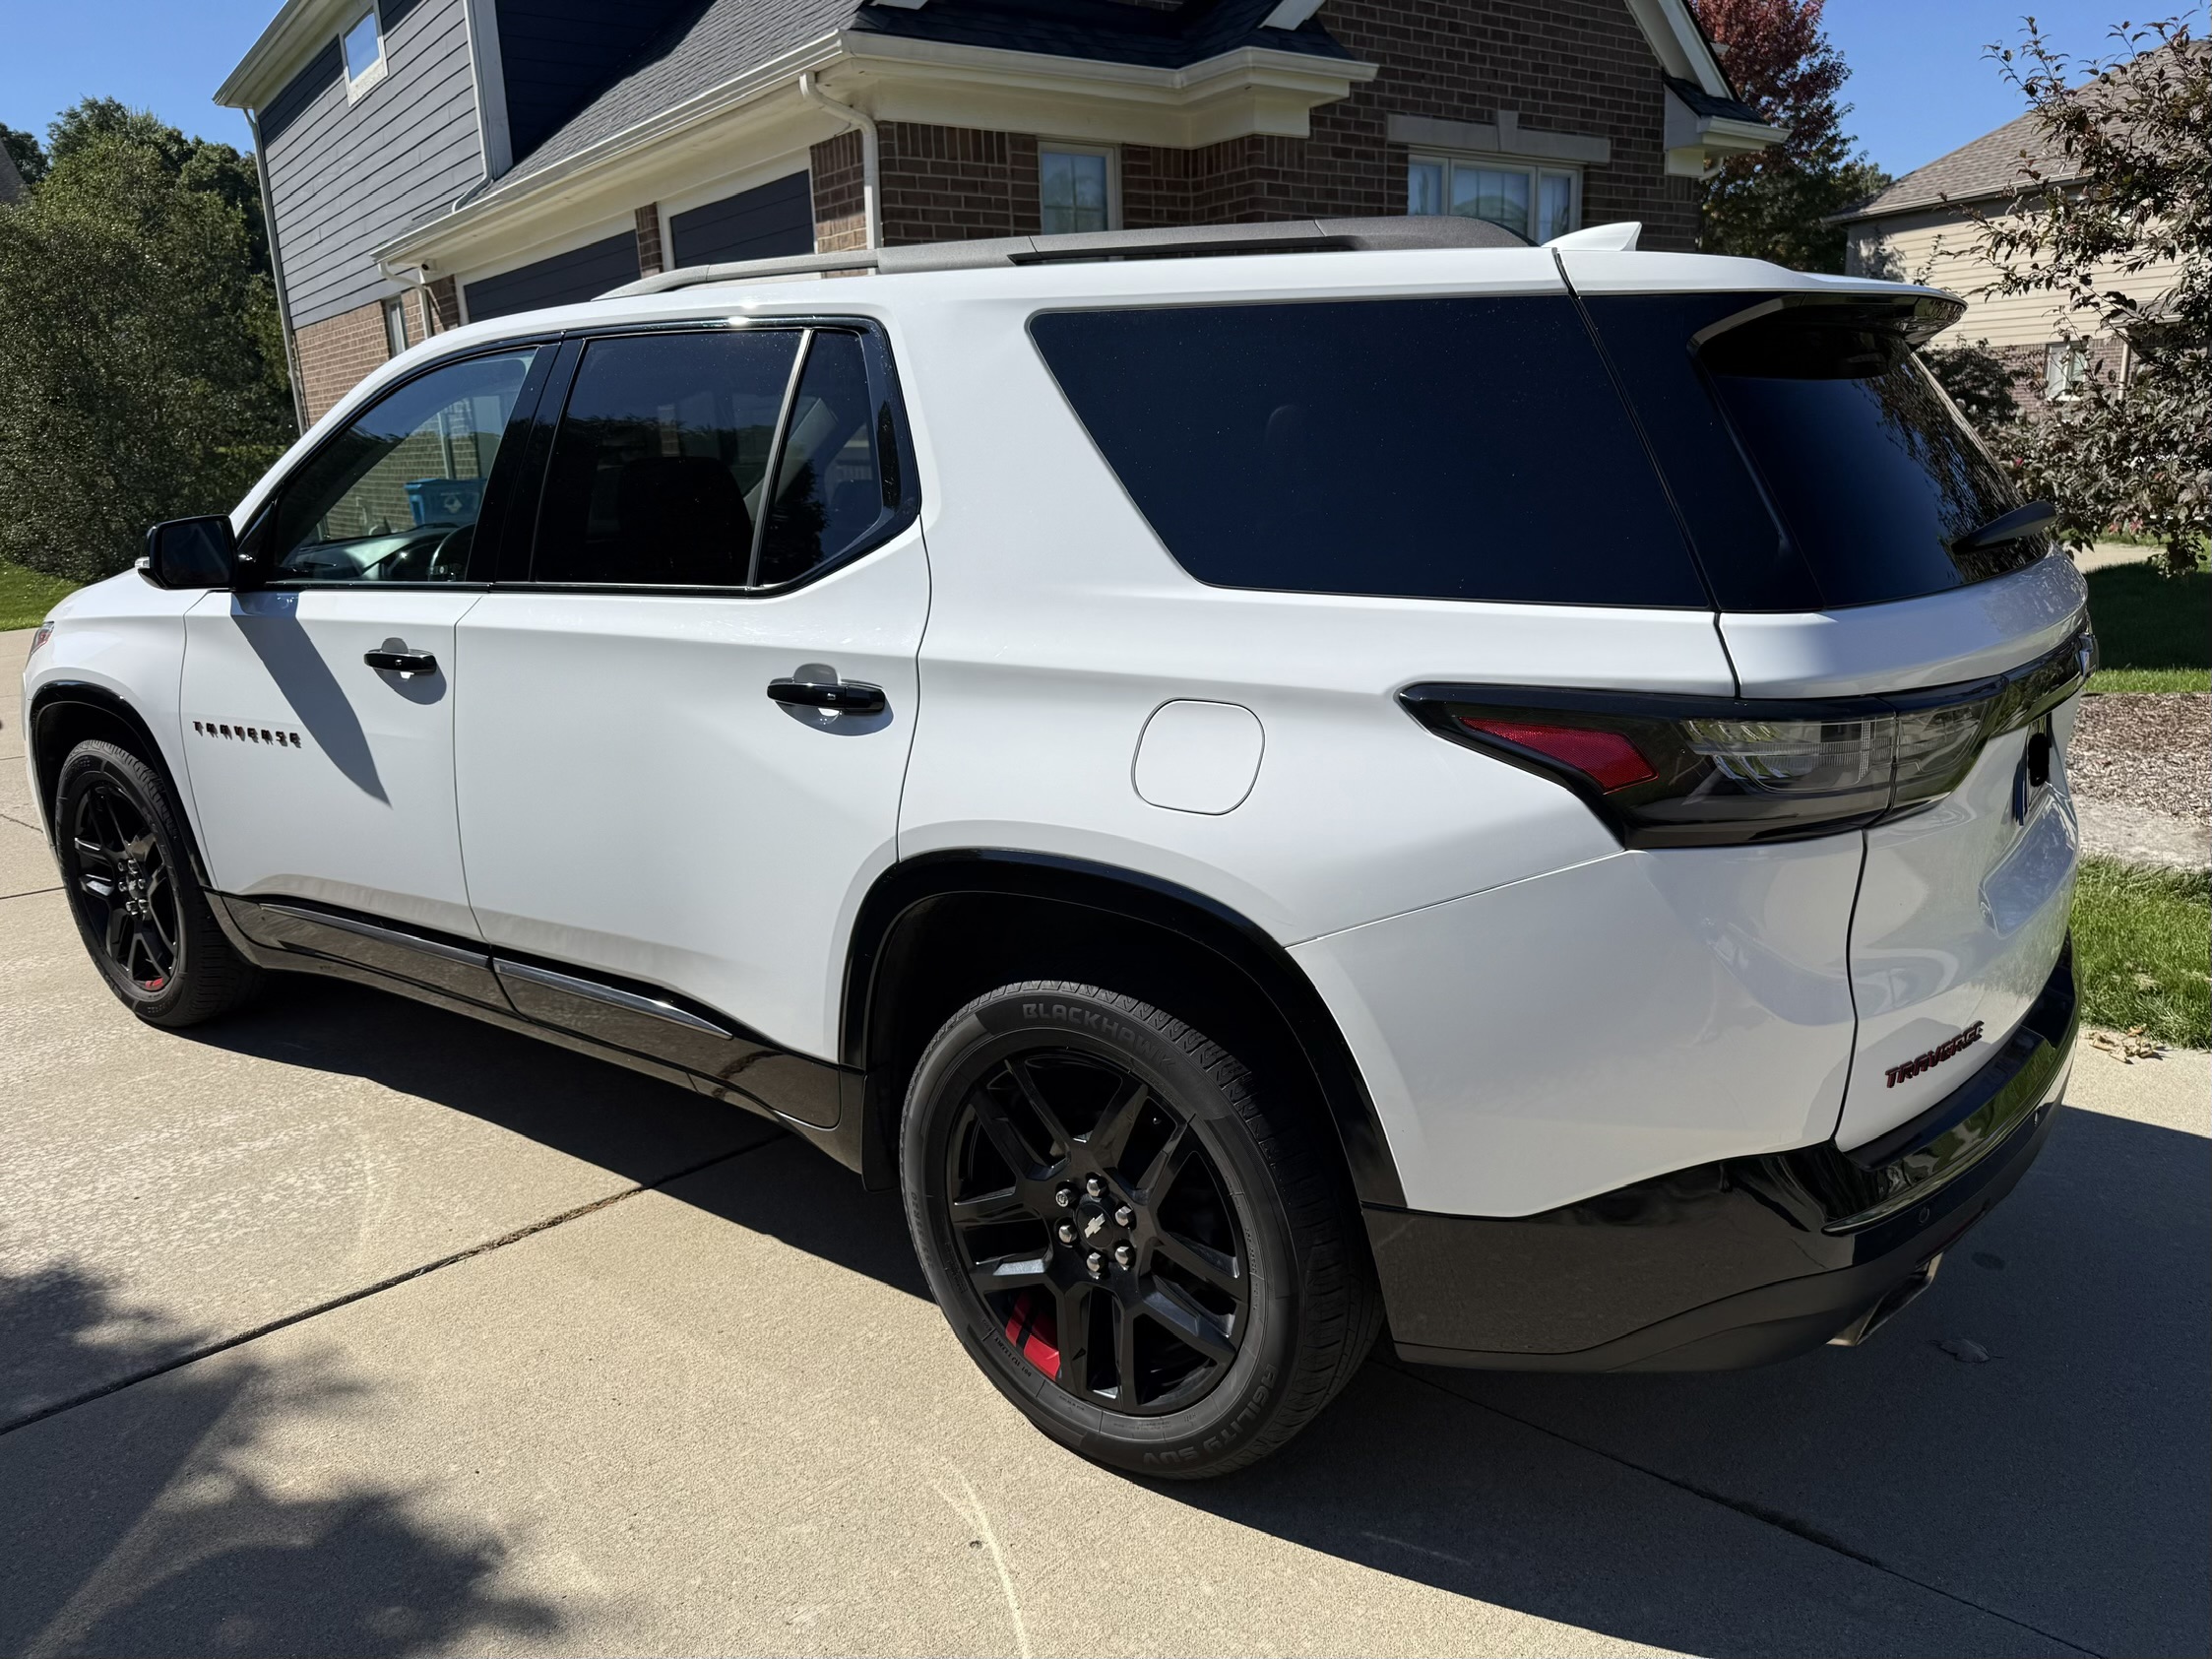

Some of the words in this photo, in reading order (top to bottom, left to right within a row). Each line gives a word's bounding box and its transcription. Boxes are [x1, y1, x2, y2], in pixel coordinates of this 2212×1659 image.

[192, 720, 302, 746] TRAVERSE
[1021, 1002, 1176, 1073] BLACKHAWK
[1884, 1020, 1985, 1088] TRAVERSE
[1202, 1363, 1279, 1454] AGILITY
[1142, 1445, 1198, 1466] SUV
